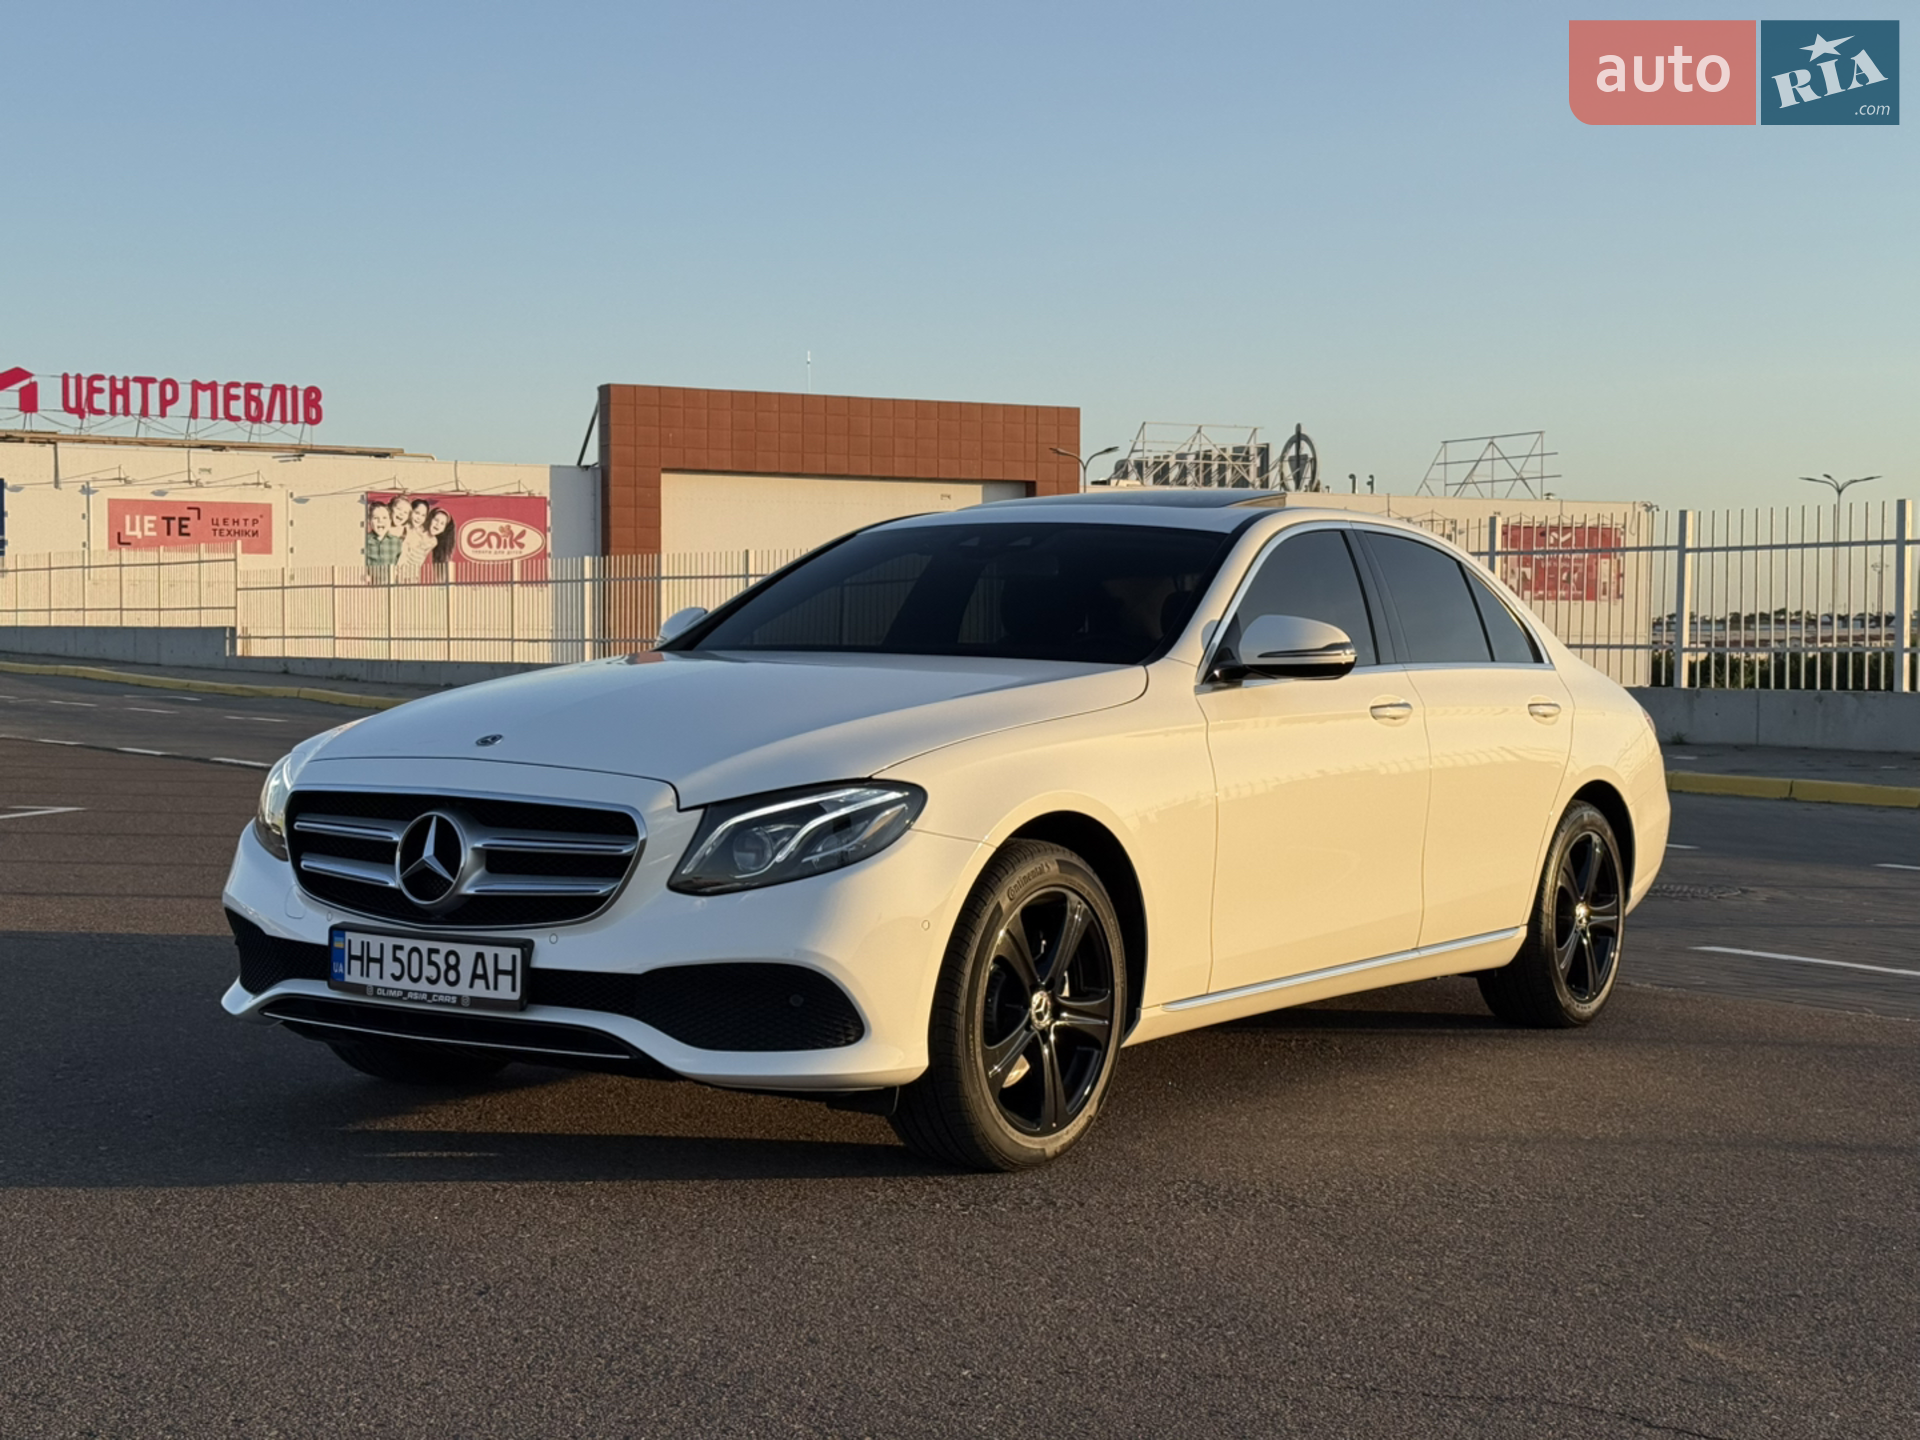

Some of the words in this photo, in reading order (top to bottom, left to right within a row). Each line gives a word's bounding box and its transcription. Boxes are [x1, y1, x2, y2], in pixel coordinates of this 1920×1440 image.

[61, 372, 179, 419] ЦЕНТР
[191, 379, 323, 425] МЕБЛІВ
[211, 517, 260, 527] ЦЕНТР
[211, 528, 260, 538] ТЕХНІКИ
[332, 961, 344, 974] UA
